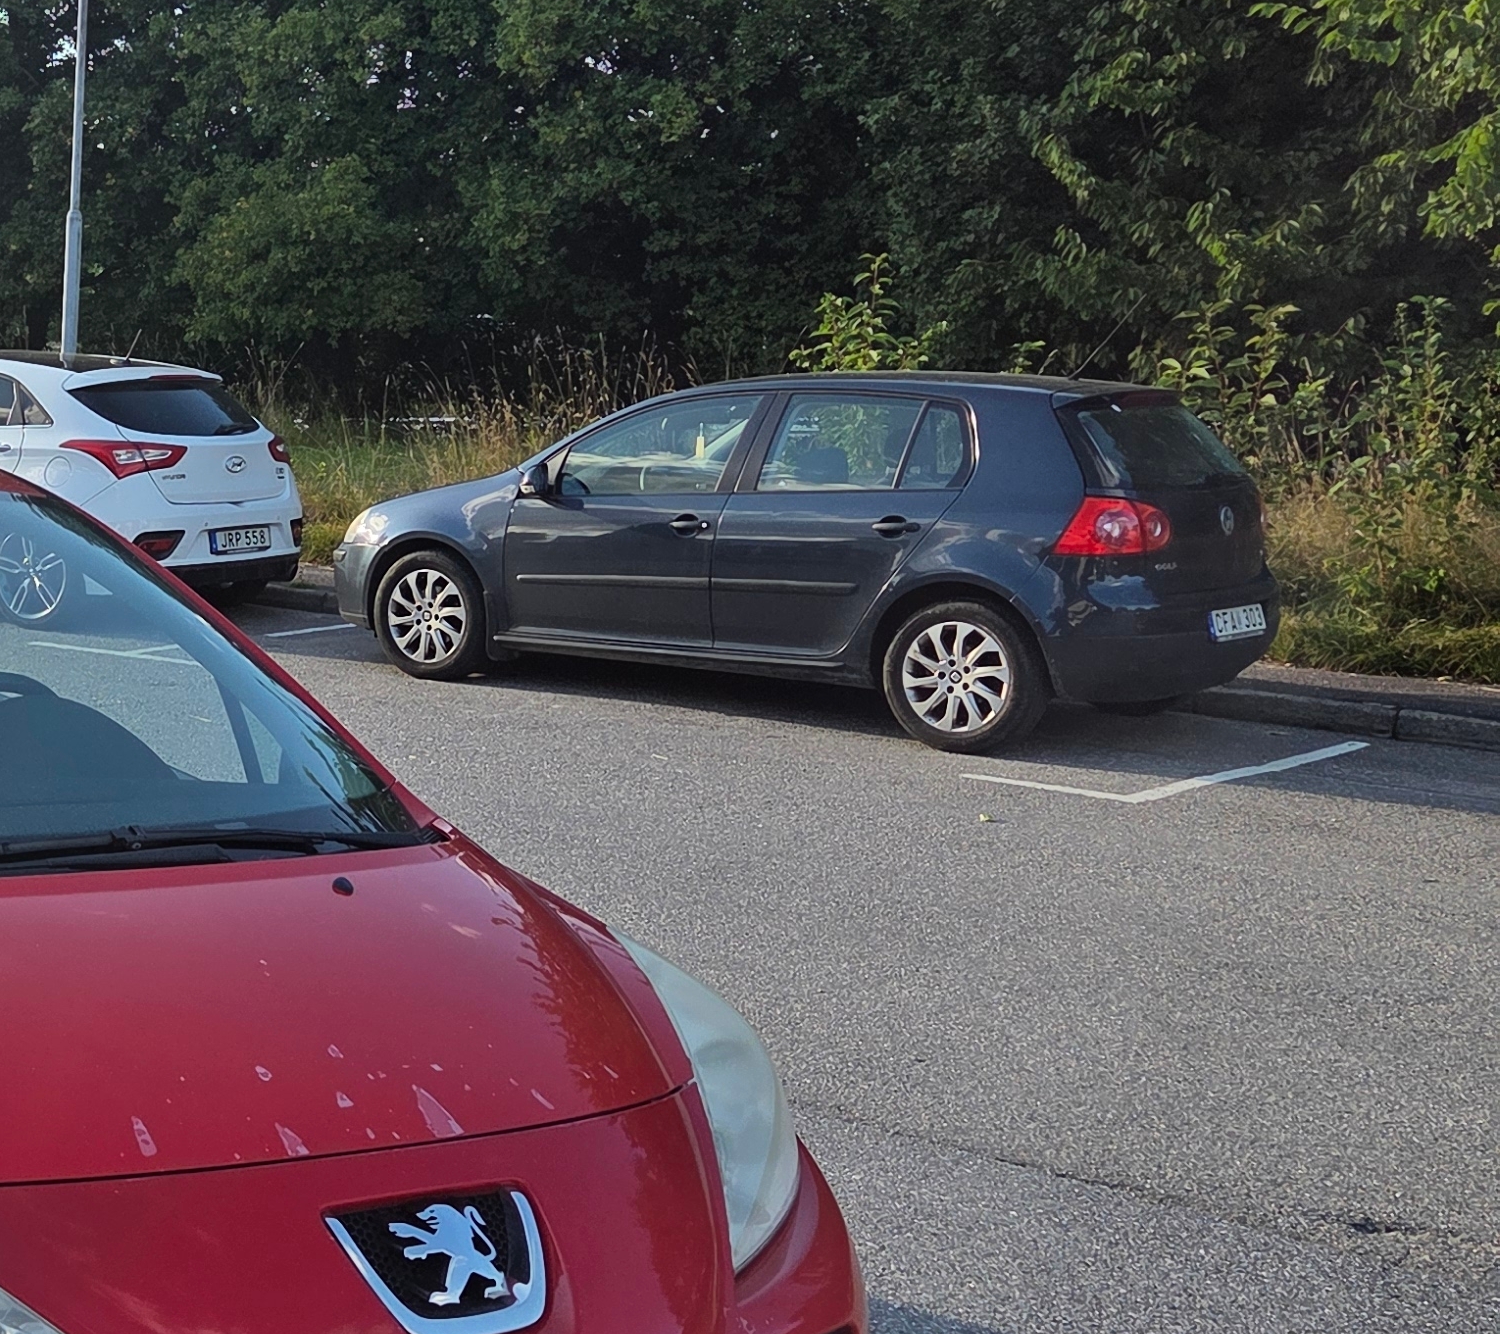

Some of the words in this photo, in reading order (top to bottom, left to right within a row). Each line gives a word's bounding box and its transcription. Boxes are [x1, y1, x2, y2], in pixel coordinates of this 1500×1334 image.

[221, 531, 242, 548] JRP
[244, 529, 266, 546] 558
[1215, 611, 1238, 633] CFA
[1243, 606, 1263, 628] 303
